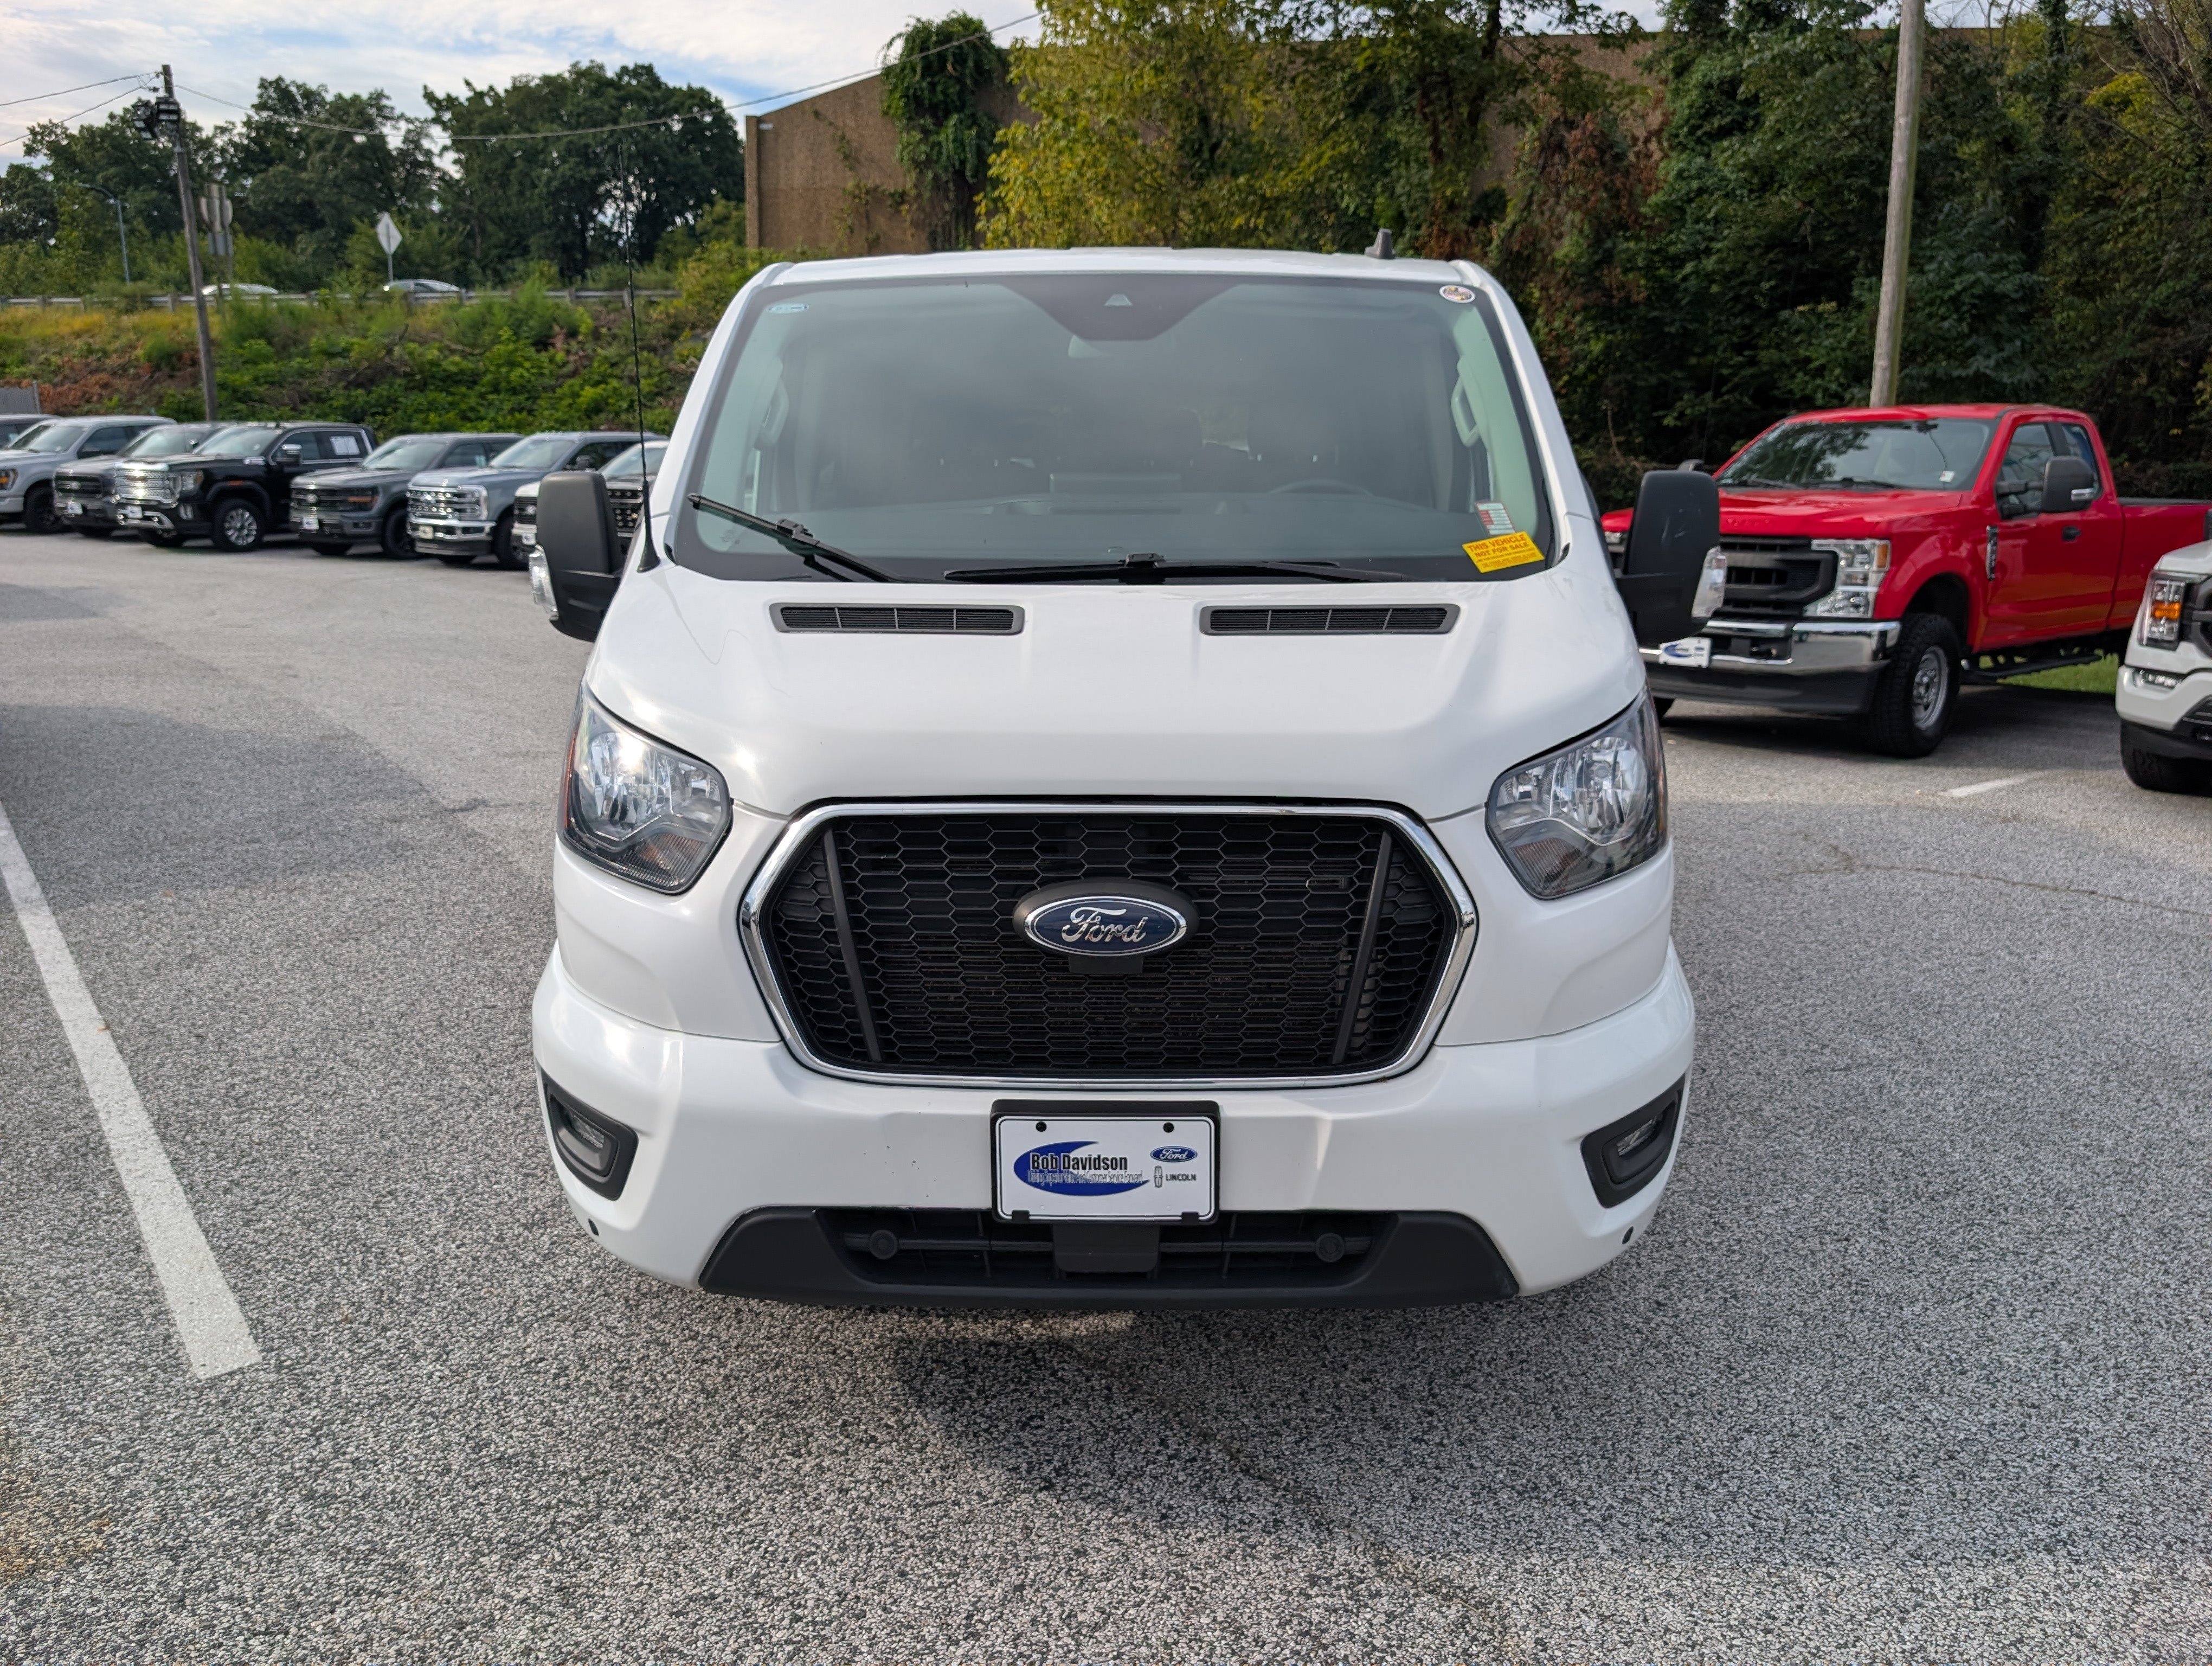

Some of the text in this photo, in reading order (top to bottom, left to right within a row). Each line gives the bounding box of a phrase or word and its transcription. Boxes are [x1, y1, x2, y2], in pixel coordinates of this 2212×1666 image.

[1467, 534, 1527, 552] THIS VEHICLE
[1474, 549, 1490, 558] NOT
[1491, 546, 1509, 555] FOR
[1509, 541, 1529, 550] SALE
[1061, 906, 1149, 943] Ford
[1031, 1153, 1128, 1170] Bob Davidson
[1159, 1148, 1188, 1159] Ford
[1166, 1173, 1197, 1182] LINCOLN
